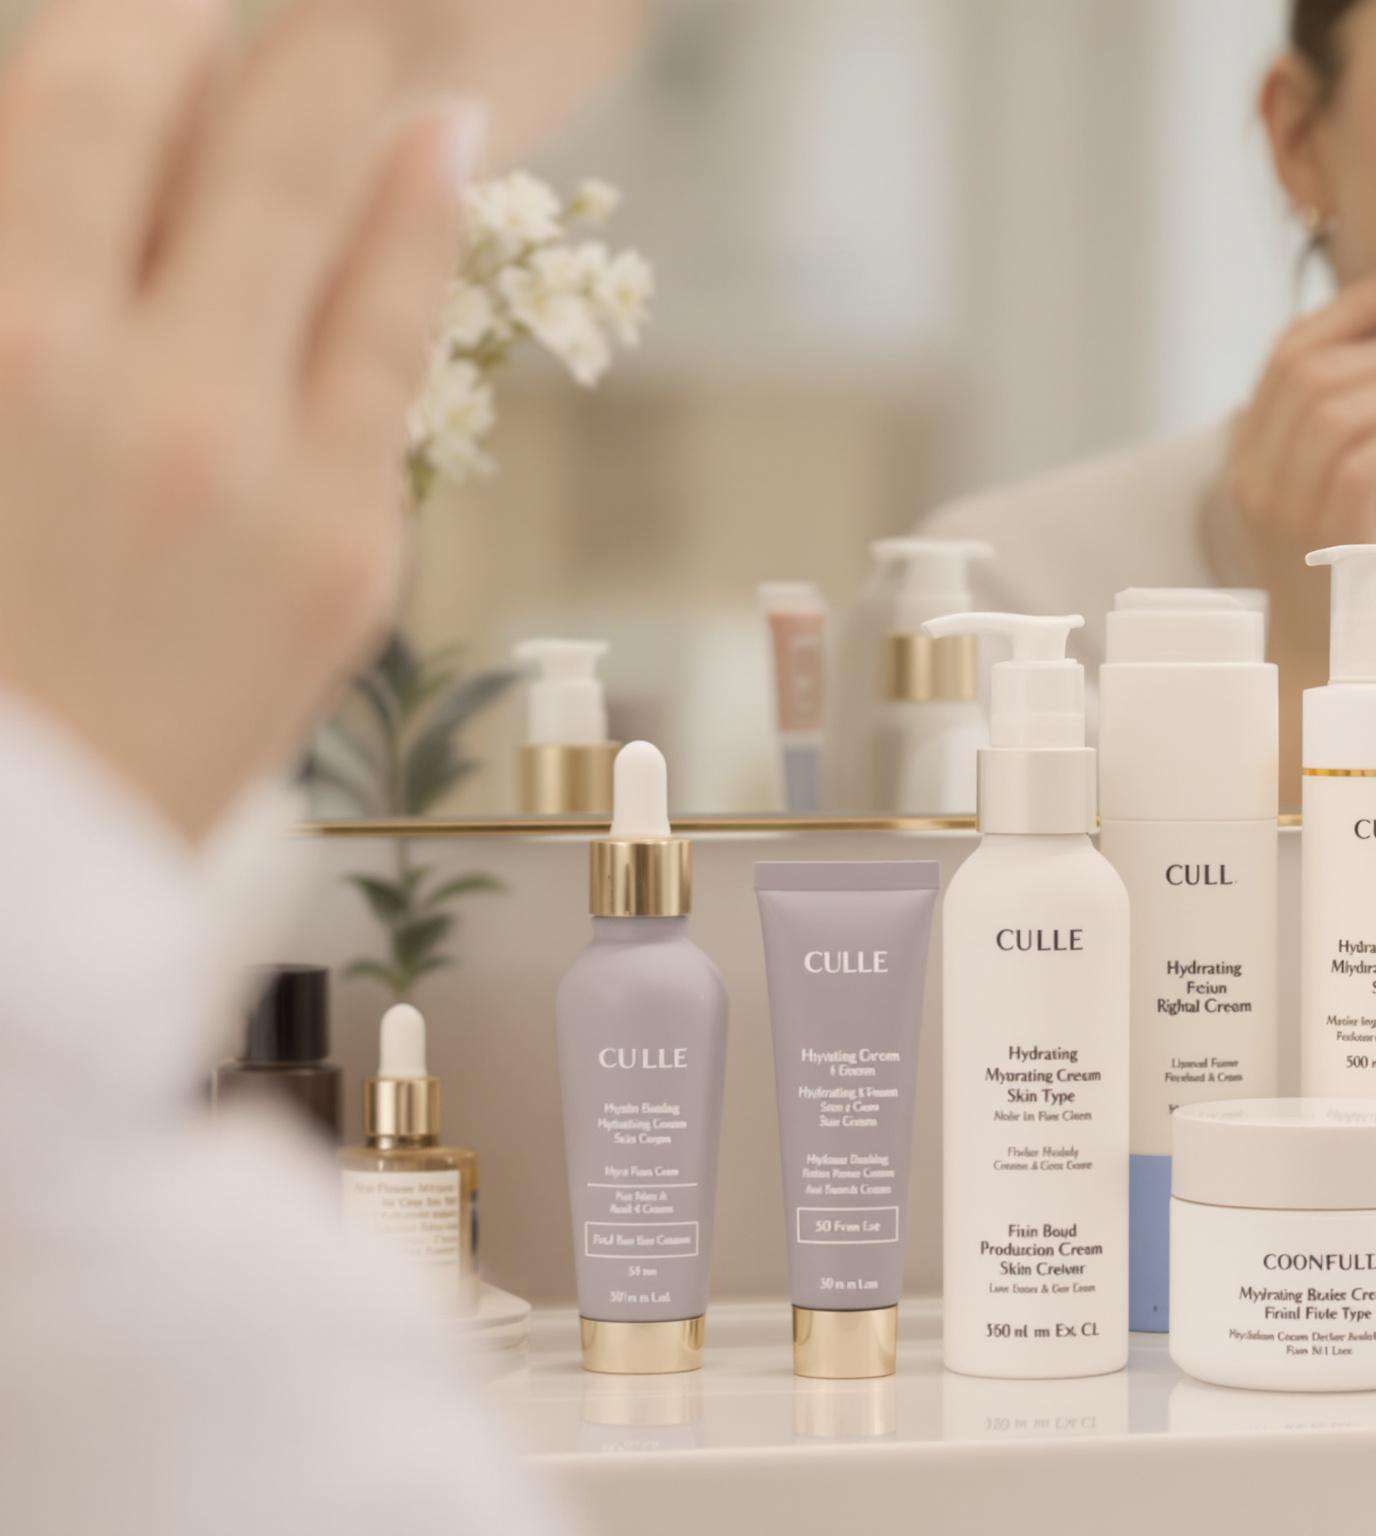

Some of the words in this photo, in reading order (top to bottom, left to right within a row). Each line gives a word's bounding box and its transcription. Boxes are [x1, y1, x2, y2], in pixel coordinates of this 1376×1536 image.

[996, 929, 1084, 951] CULLE
[804, 951, 889, 974] CULLE
[599, 1048, 688, 1069] CULLE
[1008, 1046, 1079, 1063] Hydrating
[1347, 1056, 1368, 1069] 500
[1008, 1088, 1037, 1103] Skin
[1042, 1089, 1075, 1105] Type
[1342, 1307, 1372, 1322] Type
